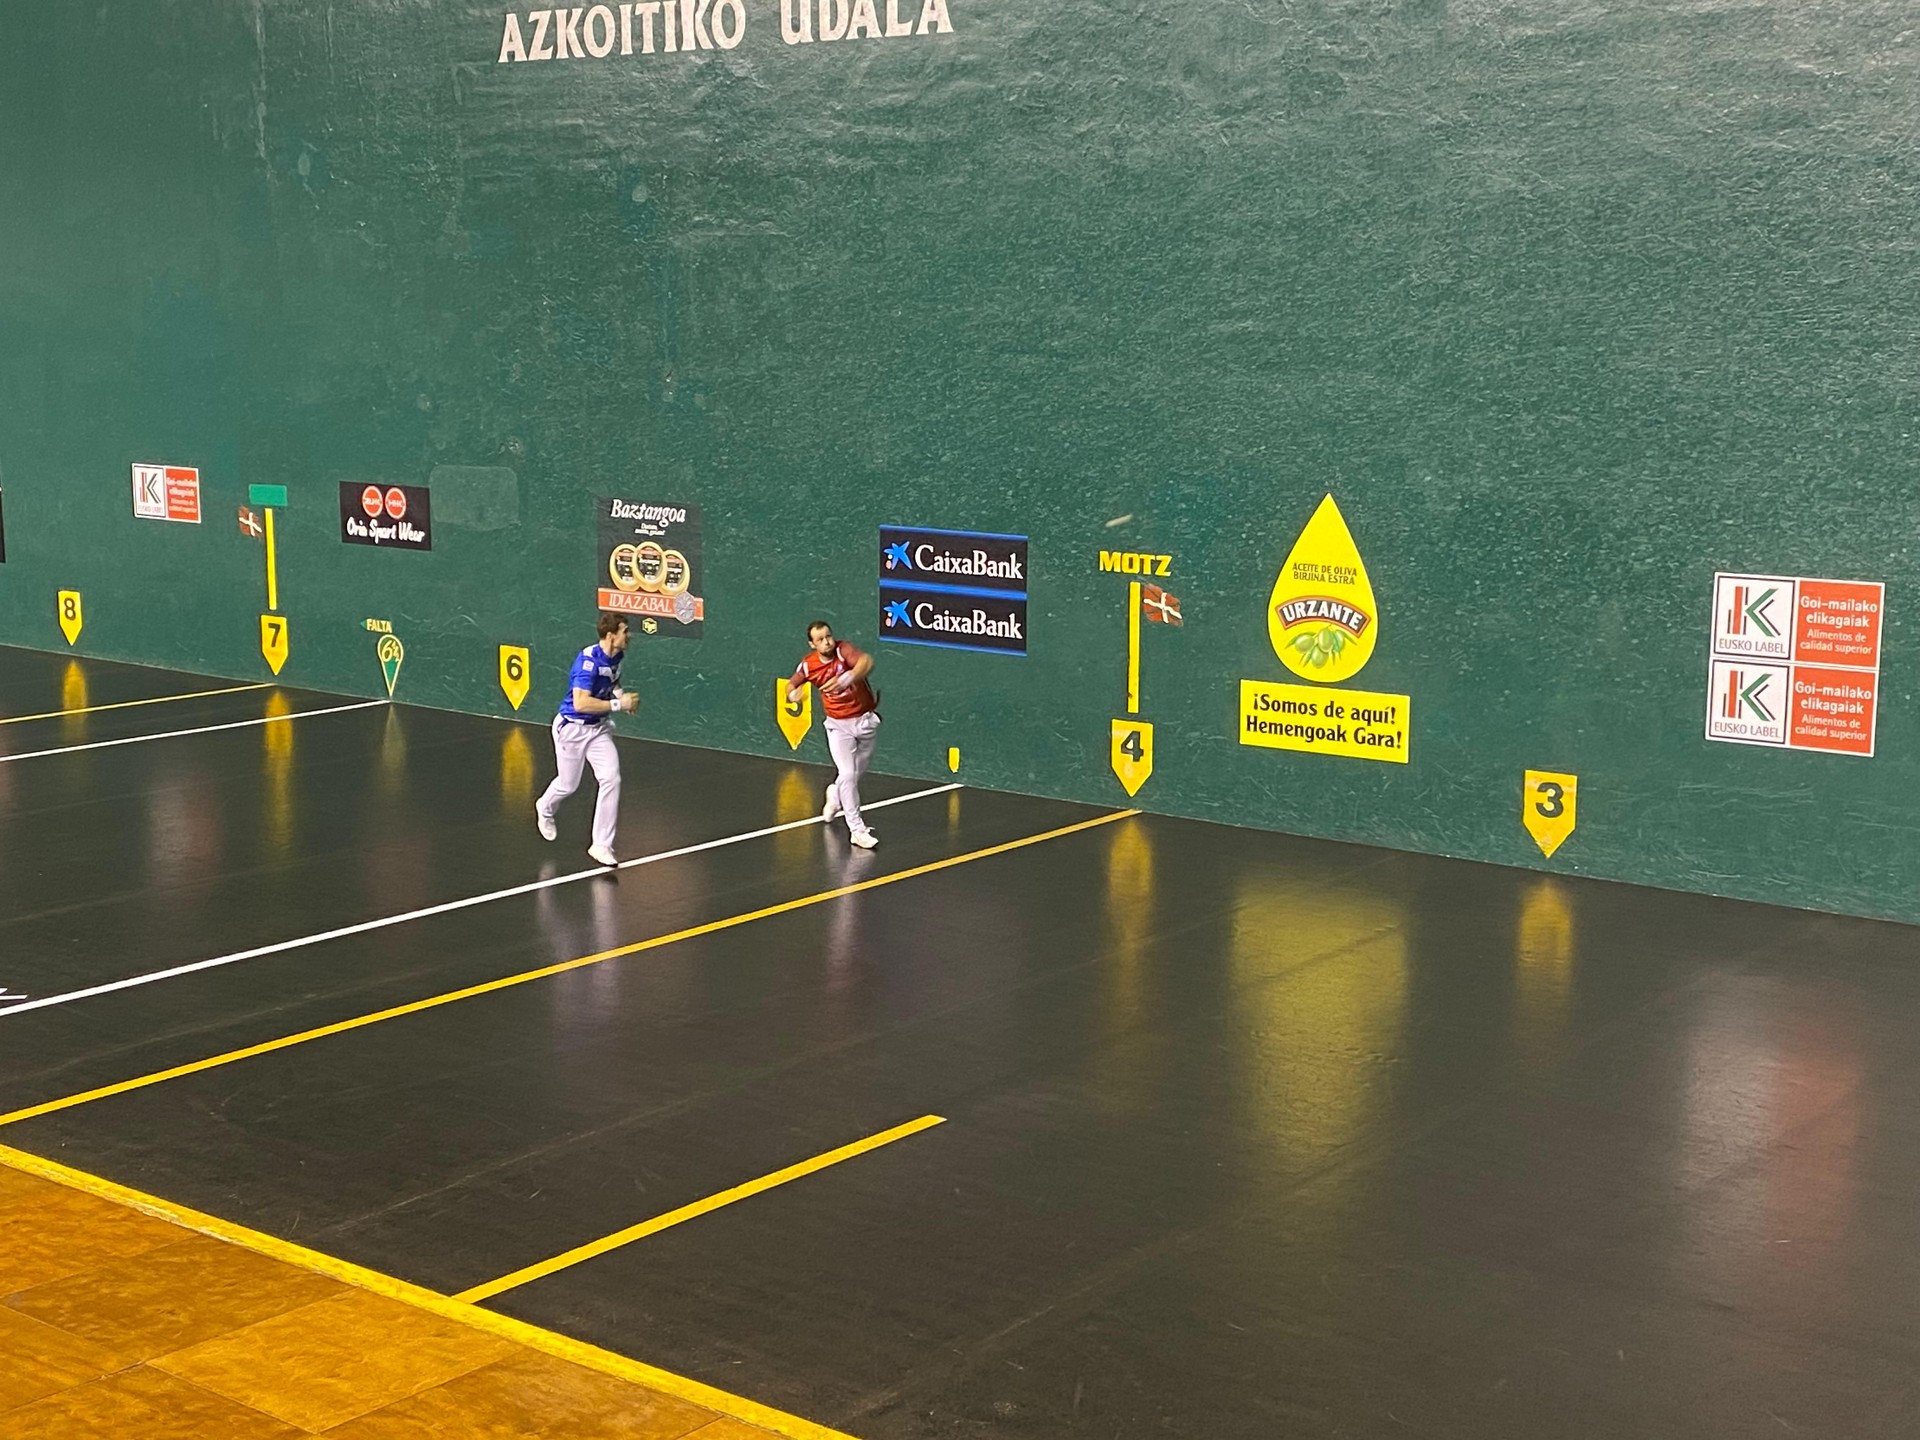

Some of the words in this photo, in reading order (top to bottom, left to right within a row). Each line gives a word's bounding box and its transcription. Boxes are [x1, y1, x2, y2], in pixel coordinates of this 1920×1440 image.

[498, 0, 747, 62] AZKOITIKO
[780, 0, 954, 45] UDALA
[610, 499, 687, 527] Baztangoa
[914, 544, 1024, 580] CaixaBank
[1099, 550, 1173, 577] MOTZ
[1291, 563, 1319, 573] ACEITE
[1321, 565, 1332, 574] DE
[1333, 566, 1358, 577] OLIVA
[1293, 571, 1326, 583] BIRJINA
[1328, 575, 1356, 585] ESTRA
[64, 597, 76, 621] 8
[609, 593, 672, 613] IDIAZABAL
[1800, 595, 1878, 613] Goi-mailako
[366, 618, 393, 633] FALTA
[914, 603, 1023, 639] CaixaBank
[1282, 600, 1363, 631] URZANTE
[1806, 612, 1870, 629] elikagaiak
[268, 622, 281, 648] 7
[1806, 629, 1852, 642] Alimentos
[1854, 633, 1867, 643] de
[1719, 638, 1752, 651] EUSKO
[1755, 641, 1786, 654] LABEL
[1800, 641, 1833, 651] calidad
[1835, 643, 1873, 655] superior
[506, 654, 523, 681] 6
[1795, 681, 1873, 700] Goi-mailako
[1253, 693, 1318, 717] ¡Somos
[1324, 700, 1345, 719] de
[1350, 706, 1396, 726] aquí!
[1800, 699, 1864, 715] elikagaiak
[1246, 714, 1348, 743] Hemengoak
[1353, 727, 1402, 749] Gara!
[1714, 722, 1748, 735] EUSKO
[1750, 725, 1781, 738] LABEL
[1801, 714, 1847, 727] Alimentos
[1849, 718, 1861, 729] de
[1795, 725, 1828, 737] calidad
[1830, 729, 1867, 741] superior
[1121, 730, 1144, 762] 4
[1535, 782, 1564, 818] 3
